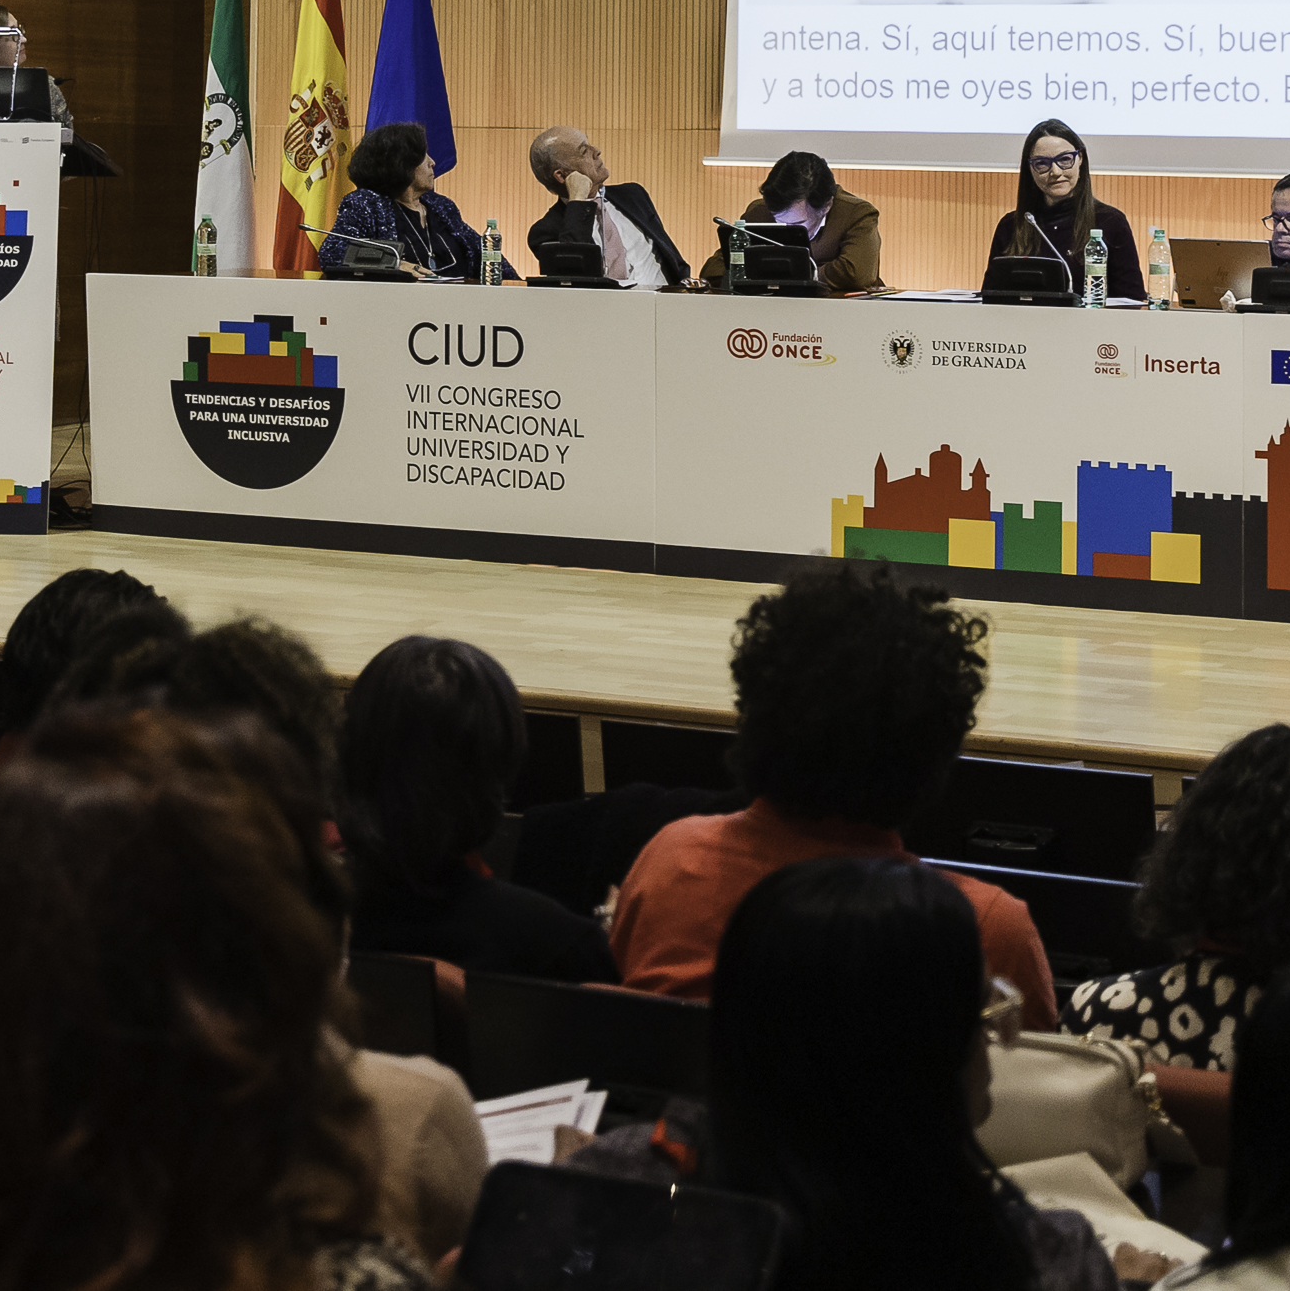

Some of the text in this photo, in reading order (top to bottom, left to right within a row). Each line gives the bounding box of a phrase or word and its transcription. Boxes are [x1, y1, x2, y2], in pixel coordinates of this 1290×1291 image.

[762, 25, 869, 52] antena.
[881, 23, 920, 56] Sí,
[931, 24, 997, 59] aquí
[1007, 25, 1150, 52] tenemos.
[1163, 23, 1204, 57] Sí,
[762, 77, 778, 104] y
[787, 77, 804, 98] a
[813, 71, 894, 99] todos
[906, 77, 950, 100] me
[961, 78, 1033, 107] oyes
[1044, 72, 1118, 107] bien,
[1131, 73, 1269, 109] perfecto.
[408, 321, 524, 368] CIUD
[772, 332, 822, 343] Fundación
[931, 340, 1027, 355] UNIVERSIDAD
[772, 344, 822, 360] ONCE
[931, 355, 1027, 370] DE GRANADA
[1094, 367, 1121, 375] ONCE
[1144, 353, 1221, 375] Inserta
[184, 393, 330, 411] TENDENCIAS Y DESAFÍOS
[406, 383, 562, 410] VII CONGRESO
[189, 410, 329, 428] PARA UNA UNIVERSIDAD
[407, 410, 585, 439] INTERNACIONAL
[227, 429, 290, 443] INCLUSIVA
[407, 436, 570, 464] UNIVERSIDAD Y
[407, 463, 565, 491] DISCAPACIDAD
